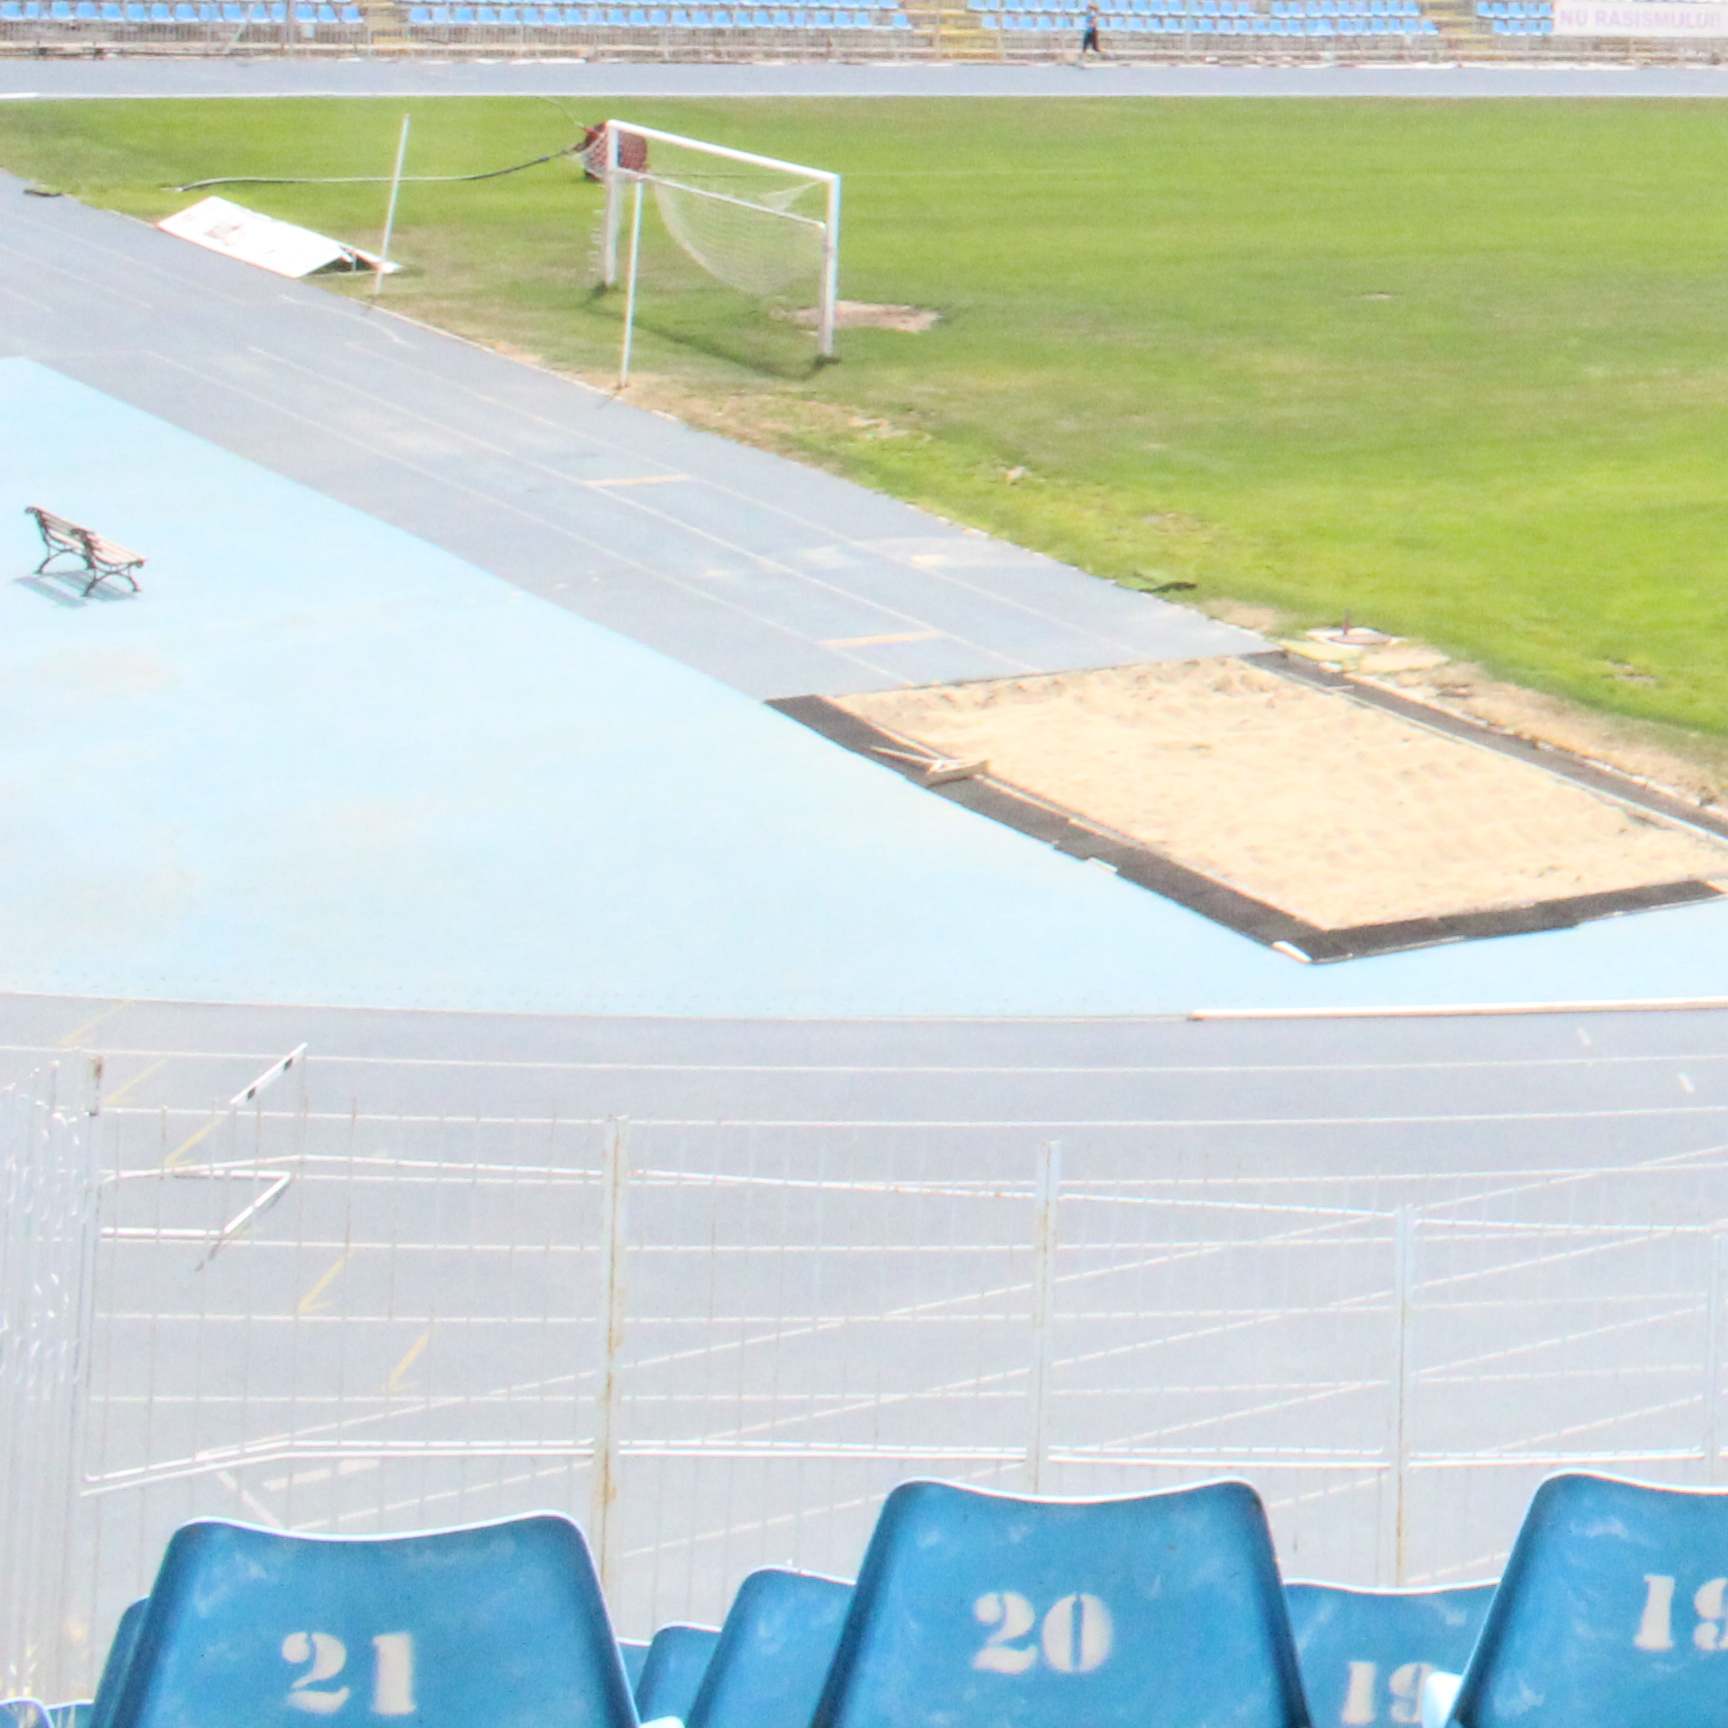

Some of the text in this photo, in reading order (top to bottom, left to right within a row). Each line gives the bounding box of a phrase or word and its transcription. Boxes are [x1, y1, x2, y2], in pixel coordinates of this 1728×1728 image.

[1558, 8, 1588, 27] NU
[971, 1590, 1114, 1674] 20
[280, 1630, 419, 1716] 21
[1341, 1661, 1425, 1725] 19
